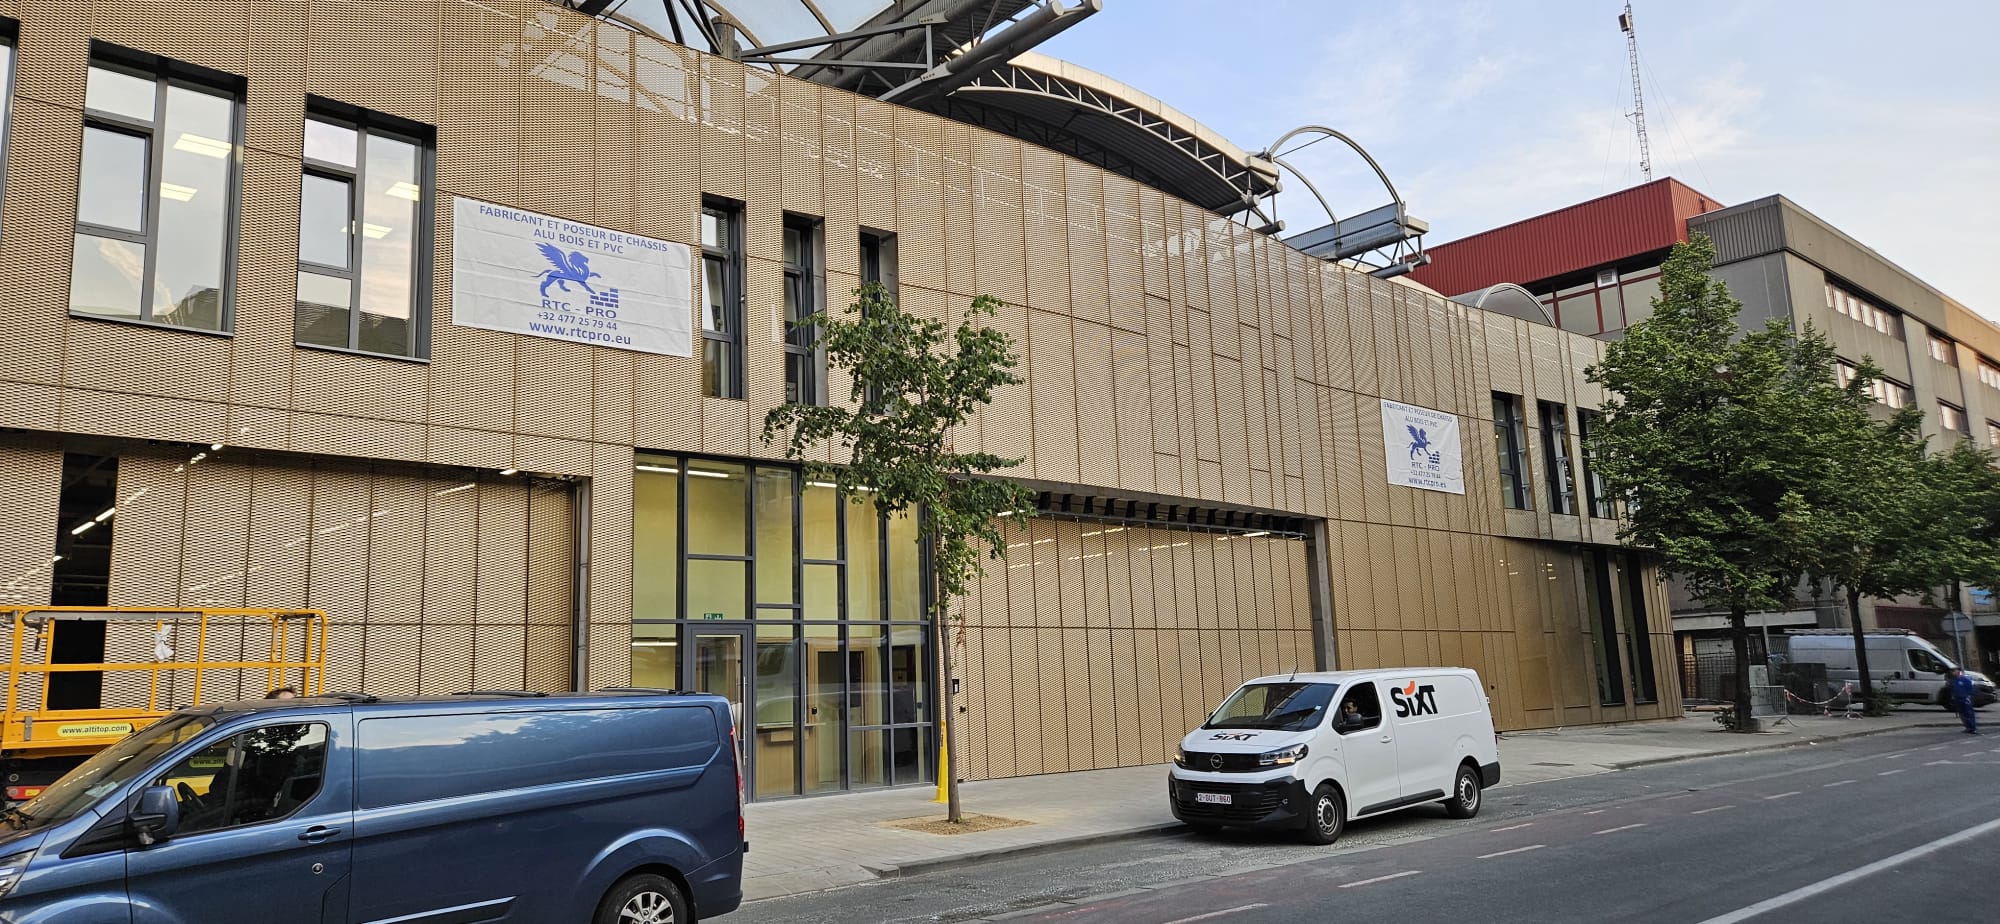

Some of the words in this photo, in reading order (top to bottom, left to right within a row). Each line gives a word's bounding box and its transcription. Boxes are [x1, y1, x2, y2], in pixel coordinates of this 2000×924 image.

[480, 205, 544, 227] FABRICANT
[547, 220, 560, 230] ET
[563, 223, 606, 240] POSEUR
[609, 233, 623, 243] DE
[626, 236, 668, 252] CHASSIS
[534, 228, 555, 240] ALU
[559, 233, 584, 247] BOIS
[588, 239, 600, 249] ET
[603, 242, 624, 254] PVC
[542, 299, 571, 312] RTC
[585, 306, 617, 319] PRO
[537, 311, 555, 321] +32
[557, 314, 576, 324] 477
[579, 317, 589, 326] 25
[592, 319, 604, 329] 79
[606, 321, 618, 330] 44
[529, 322, 631, 345] www.rtcpro.eu
[1411, 461, 1422, 469] RTC
[1427, 463, 1440, 471] PRO
[1391, 680, 1438, 718] SIXT
[62, 724, 128, 734] www.altitop.com
[1208, 732, 1258, 741] SIXT
